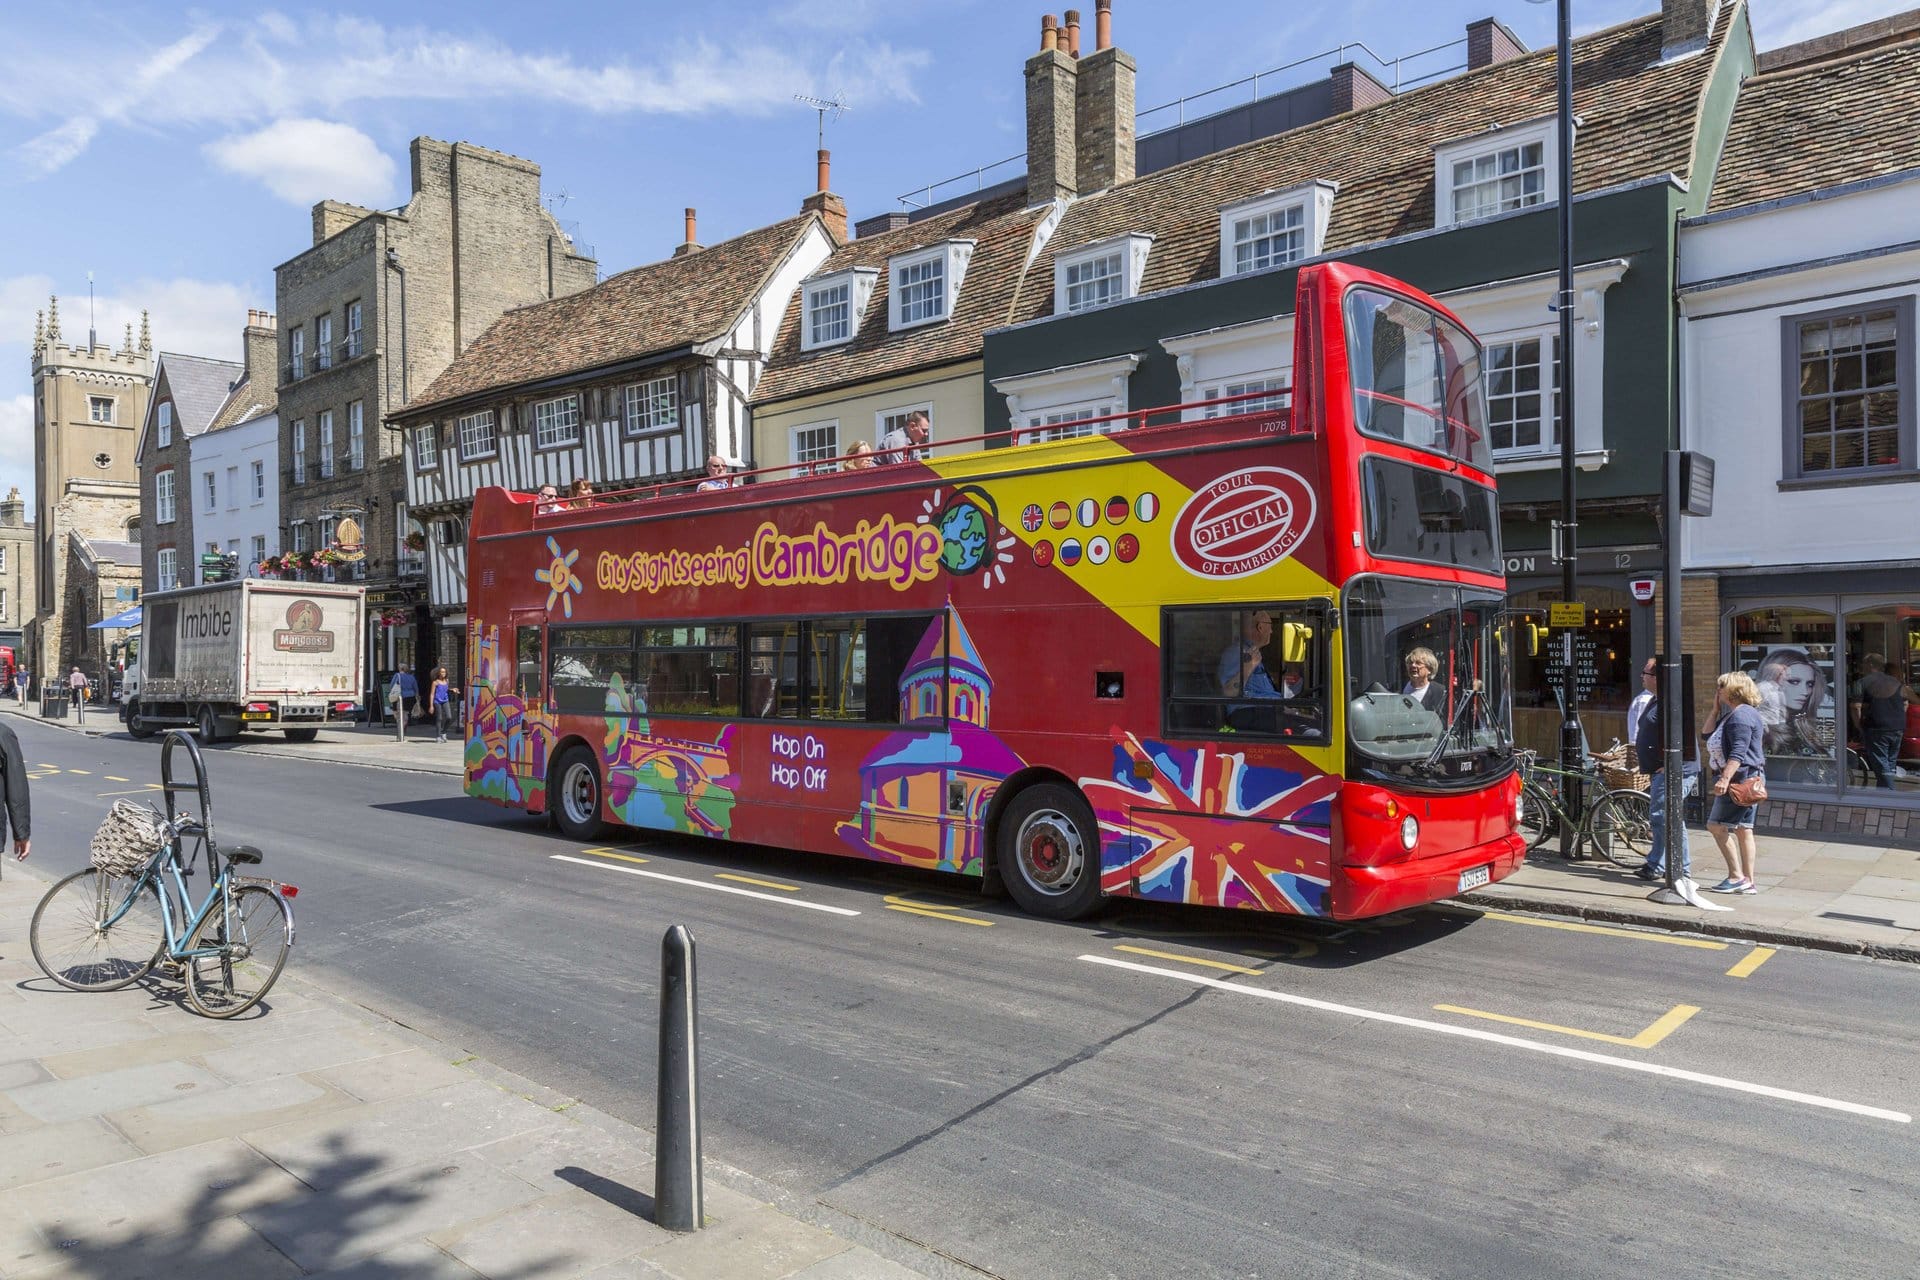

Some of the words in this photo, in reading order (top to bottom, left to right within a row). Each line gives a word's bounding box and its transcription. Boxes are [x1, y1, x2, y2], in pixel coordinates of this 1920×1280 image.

[1260, 420, 1287, 433] 17078
[1207, 473, 1254, 499] TOUR
[1196, 499, 1289, 546] OFFICIAL
[753, 513, 943, 591] Cambridge
[1202, 561, 1221, 575] OF
[1222, 528, 1299, 575] CAMBRIDGE
[1614, 554, 1631, 569] 12
[181, 604, 232, 639] Imbibe
[772, 733, 800, 759] Hop
[804, 735, 824, 759] On
[771, 762, 800, 789] Hop
[804, 765, 827, 789] Off
